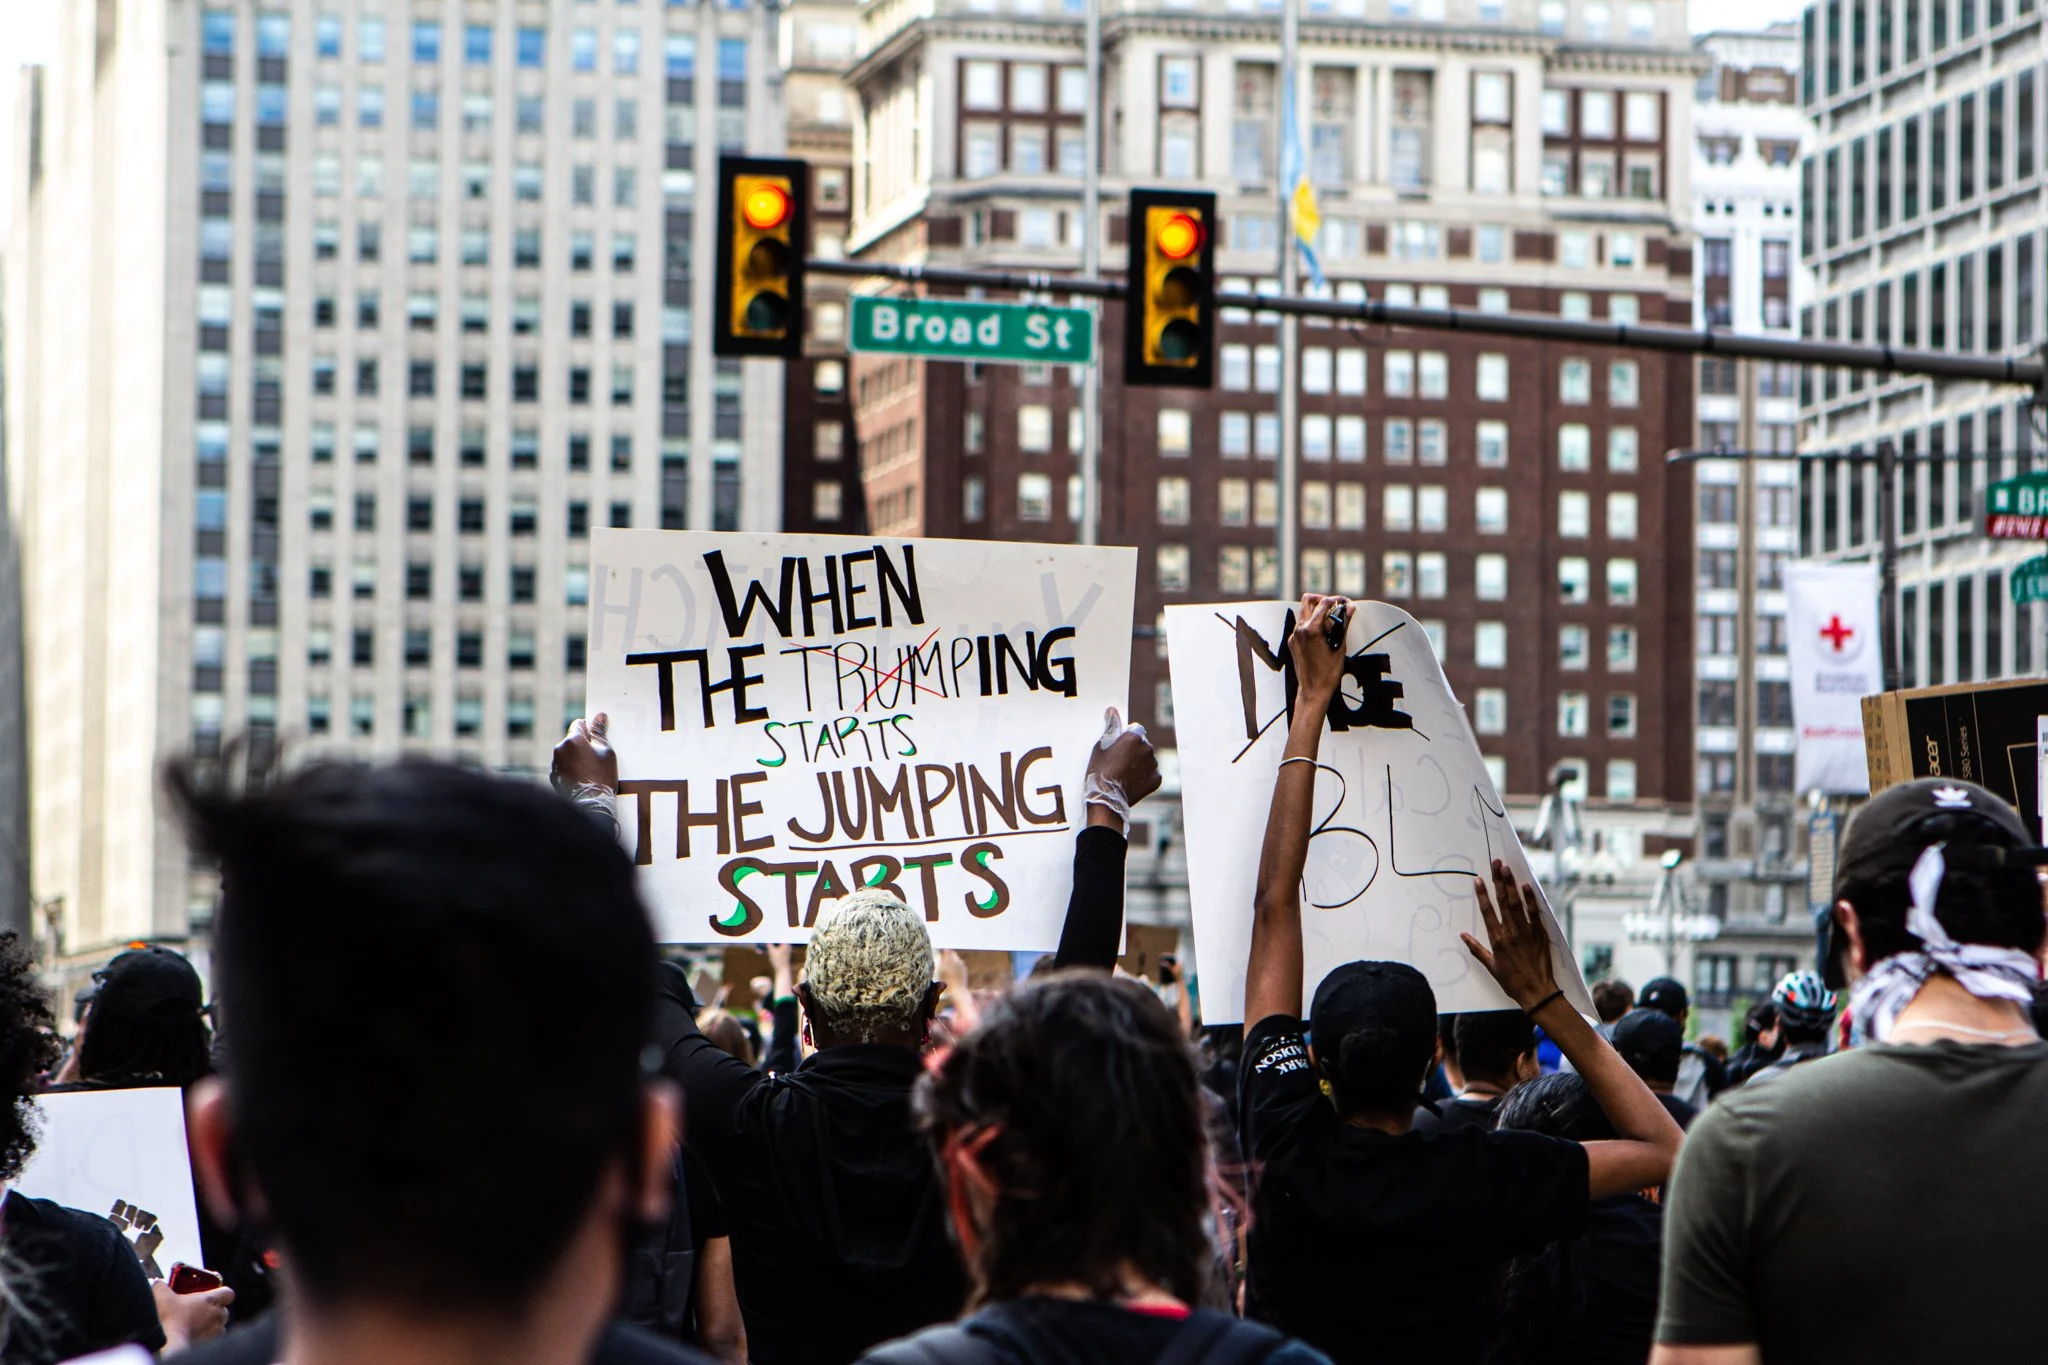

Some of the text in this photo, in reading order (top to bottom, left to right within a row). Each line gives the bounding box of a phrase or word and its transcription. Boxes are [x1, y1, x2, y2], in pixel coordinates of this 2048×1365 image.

[872, 305, 1071, 350] Broad St
[702, 544, 924, 638] WHEN
[625, 627, 1078, 732] THE TRUMPING
[756, 714, 918, 767] STARTS
[1926, 735, 1941, 776] acer
[1959, 725, 1970, 757] Series
[617, 746, 1067, 866] THE JUMPING
